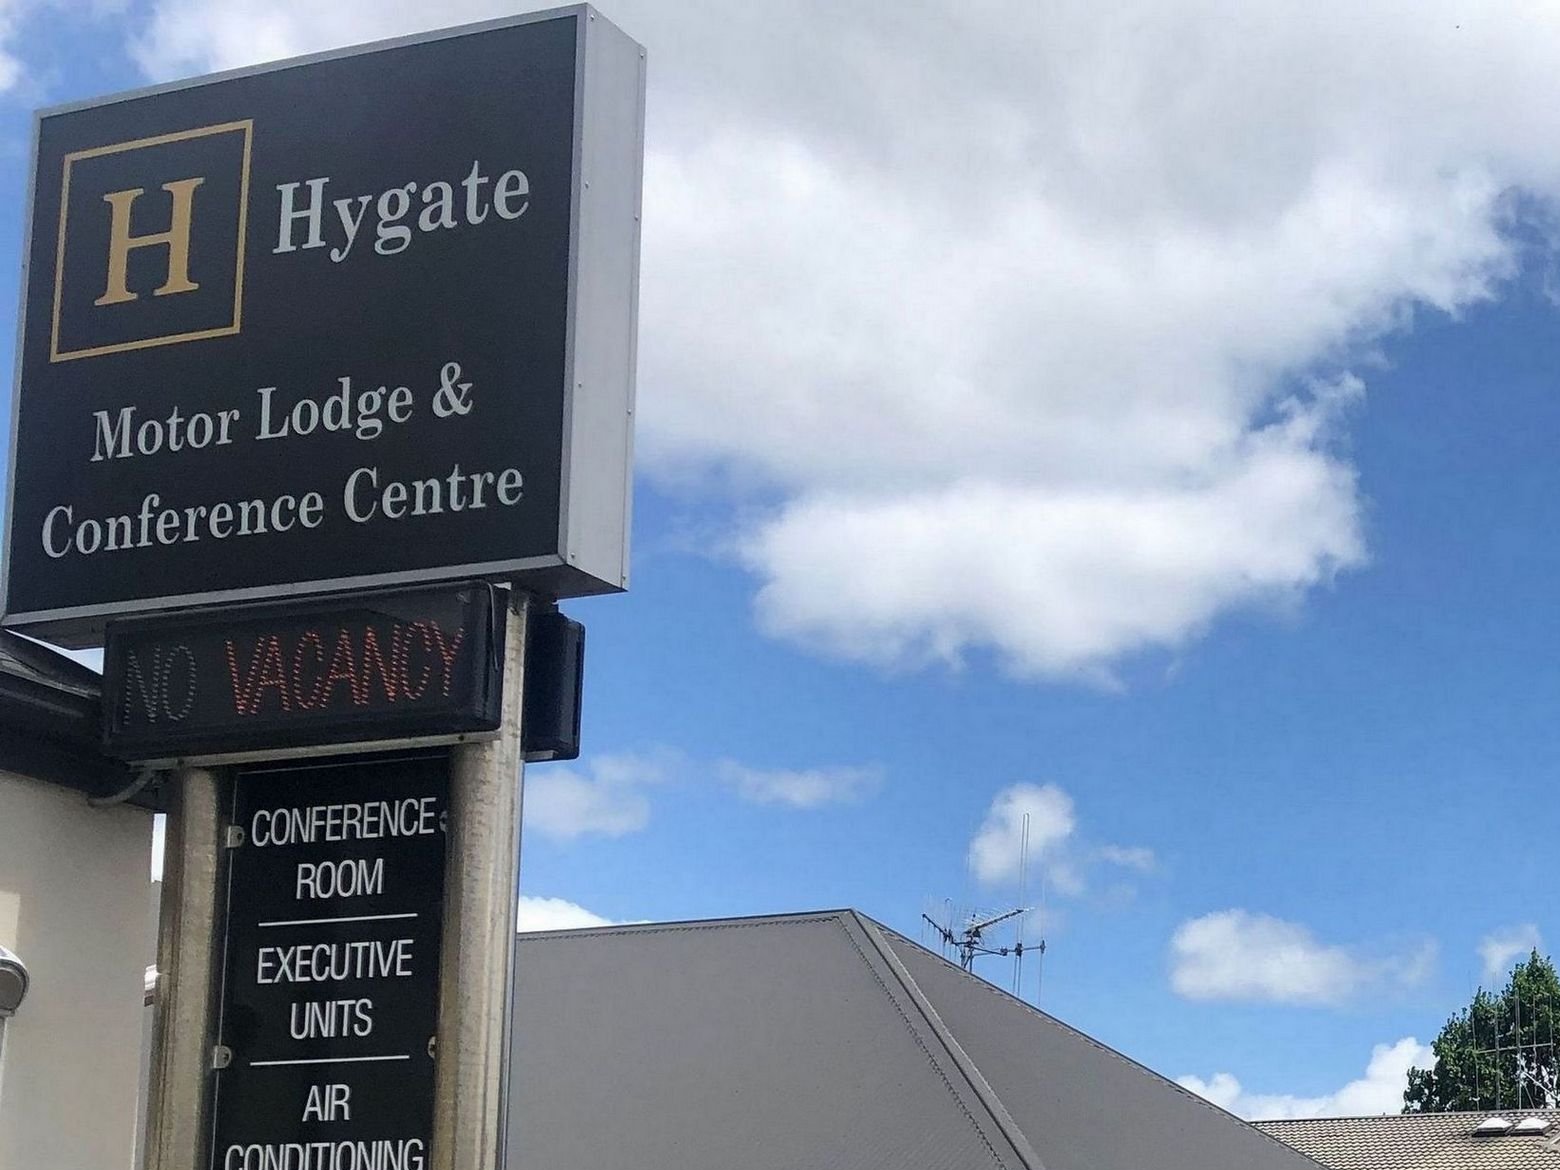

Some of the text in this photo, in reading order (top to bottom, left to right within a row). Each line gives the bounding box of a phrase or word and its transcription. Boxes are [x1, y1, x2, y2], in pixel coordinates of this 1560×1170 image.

[94, 176, 204, 306] H
[272, 160, 530, 262] Hygate
[89, 361, 474, 462] Motor Lodge &
[41, 463, 524, 559] Conference Centre
[123, 620, 465, 724] NO VACANCY
[251, 797, 437, 847] CONFERENCE
[296, 858, 384, 900] ROOM
[257, 939, 414, 984] EXECUTIVE
[290, 998, 373, 1040] UNITS
[302, 1083, 350, 1122] AIR
